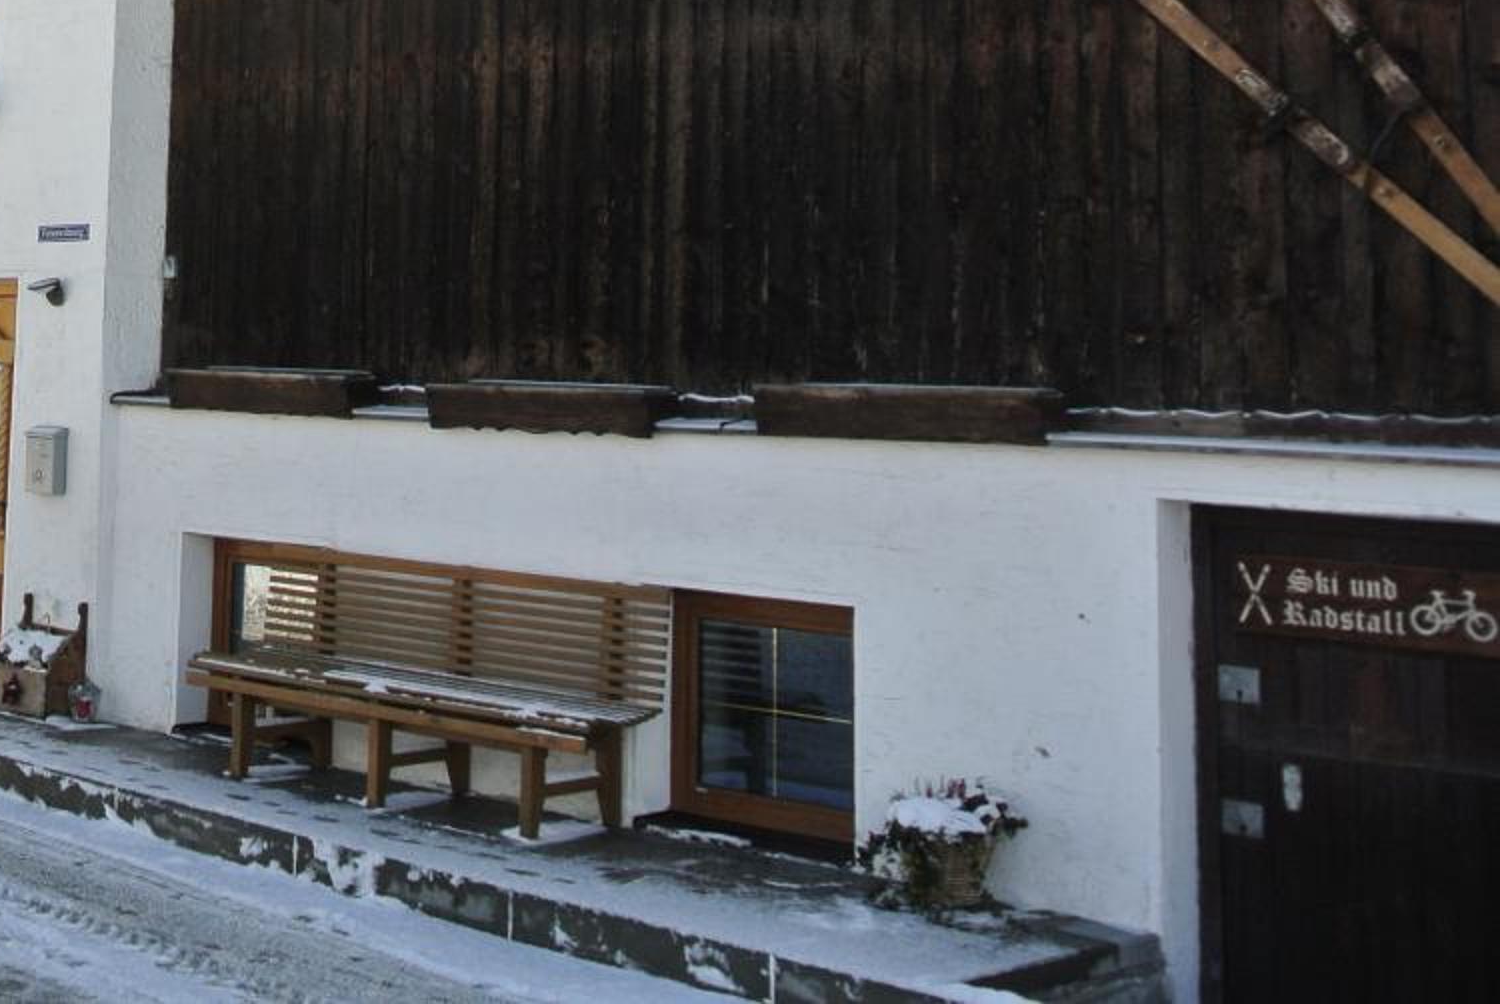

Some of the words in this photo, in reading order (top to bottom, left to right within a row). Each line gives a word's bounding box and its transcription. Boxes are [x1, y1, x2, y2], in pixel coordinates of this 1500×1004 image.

[1286, 567, 1339, 596] Ski
[1349, 576, 1398, 601] und
[1283, 599, 1407, 636] Radstall
